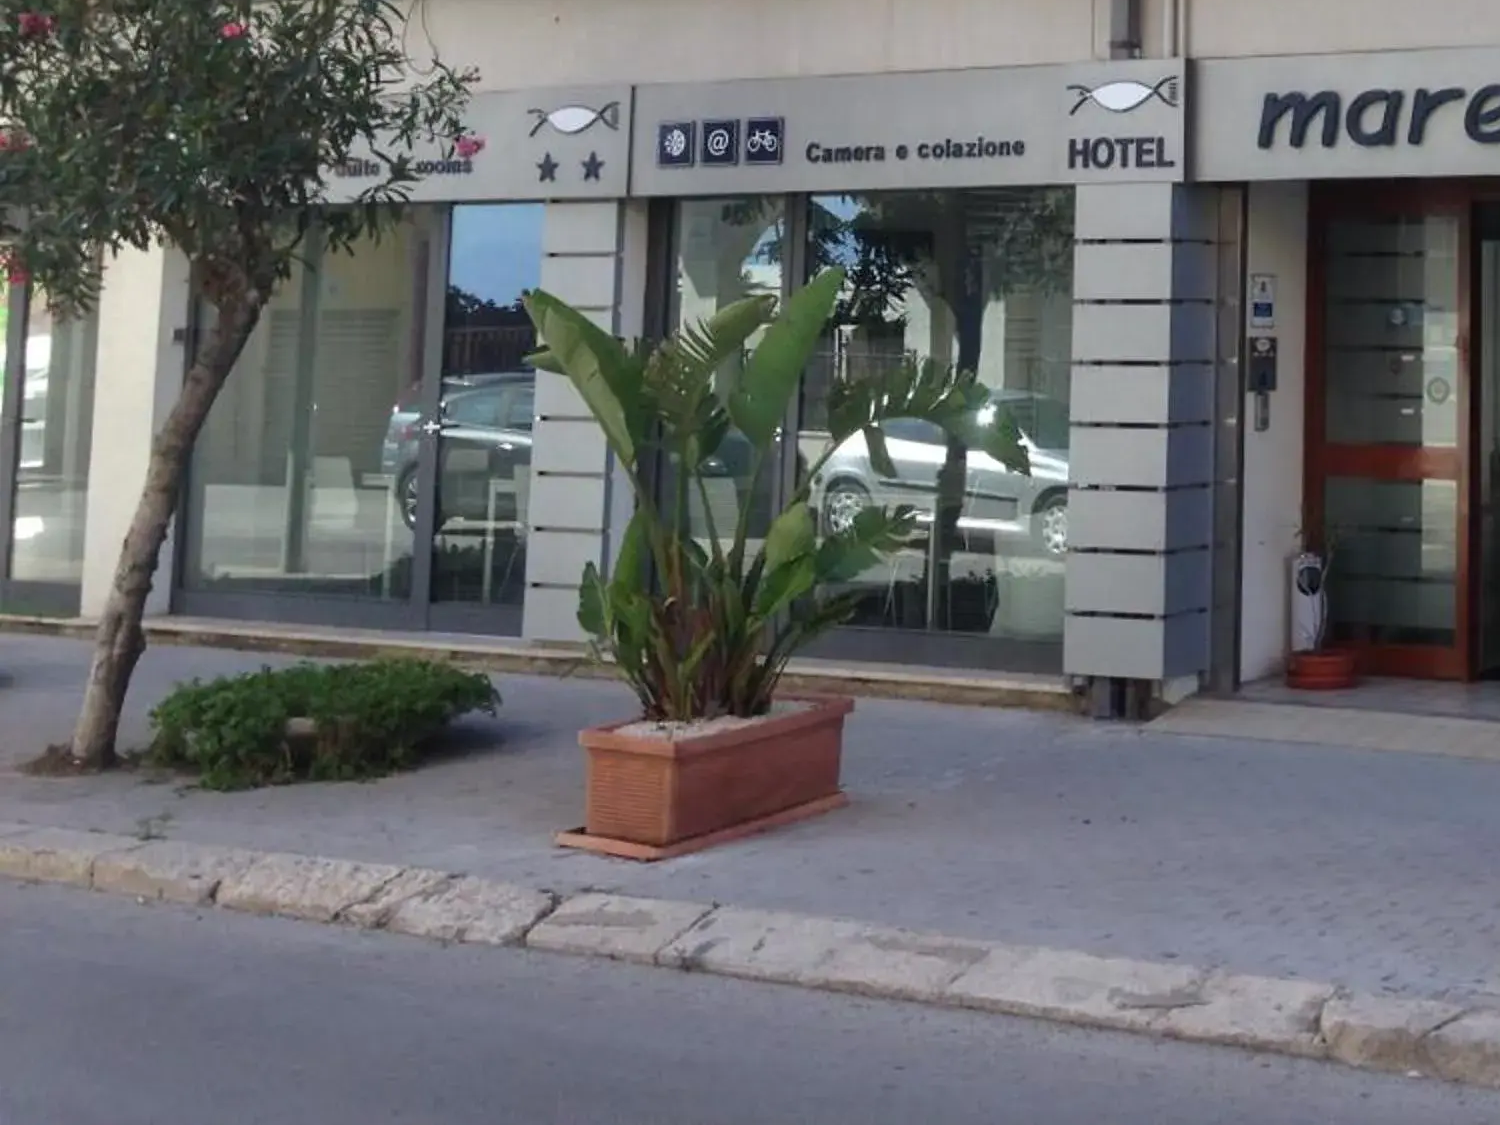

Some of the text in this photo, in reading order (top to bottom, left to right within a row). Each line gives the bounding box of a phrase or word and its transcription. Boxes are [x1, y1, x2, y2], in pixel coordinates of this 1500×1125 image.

[805, 136, 1026, 164] Camera e colazione
[1067, 136, 1175, 169] HOTEL
